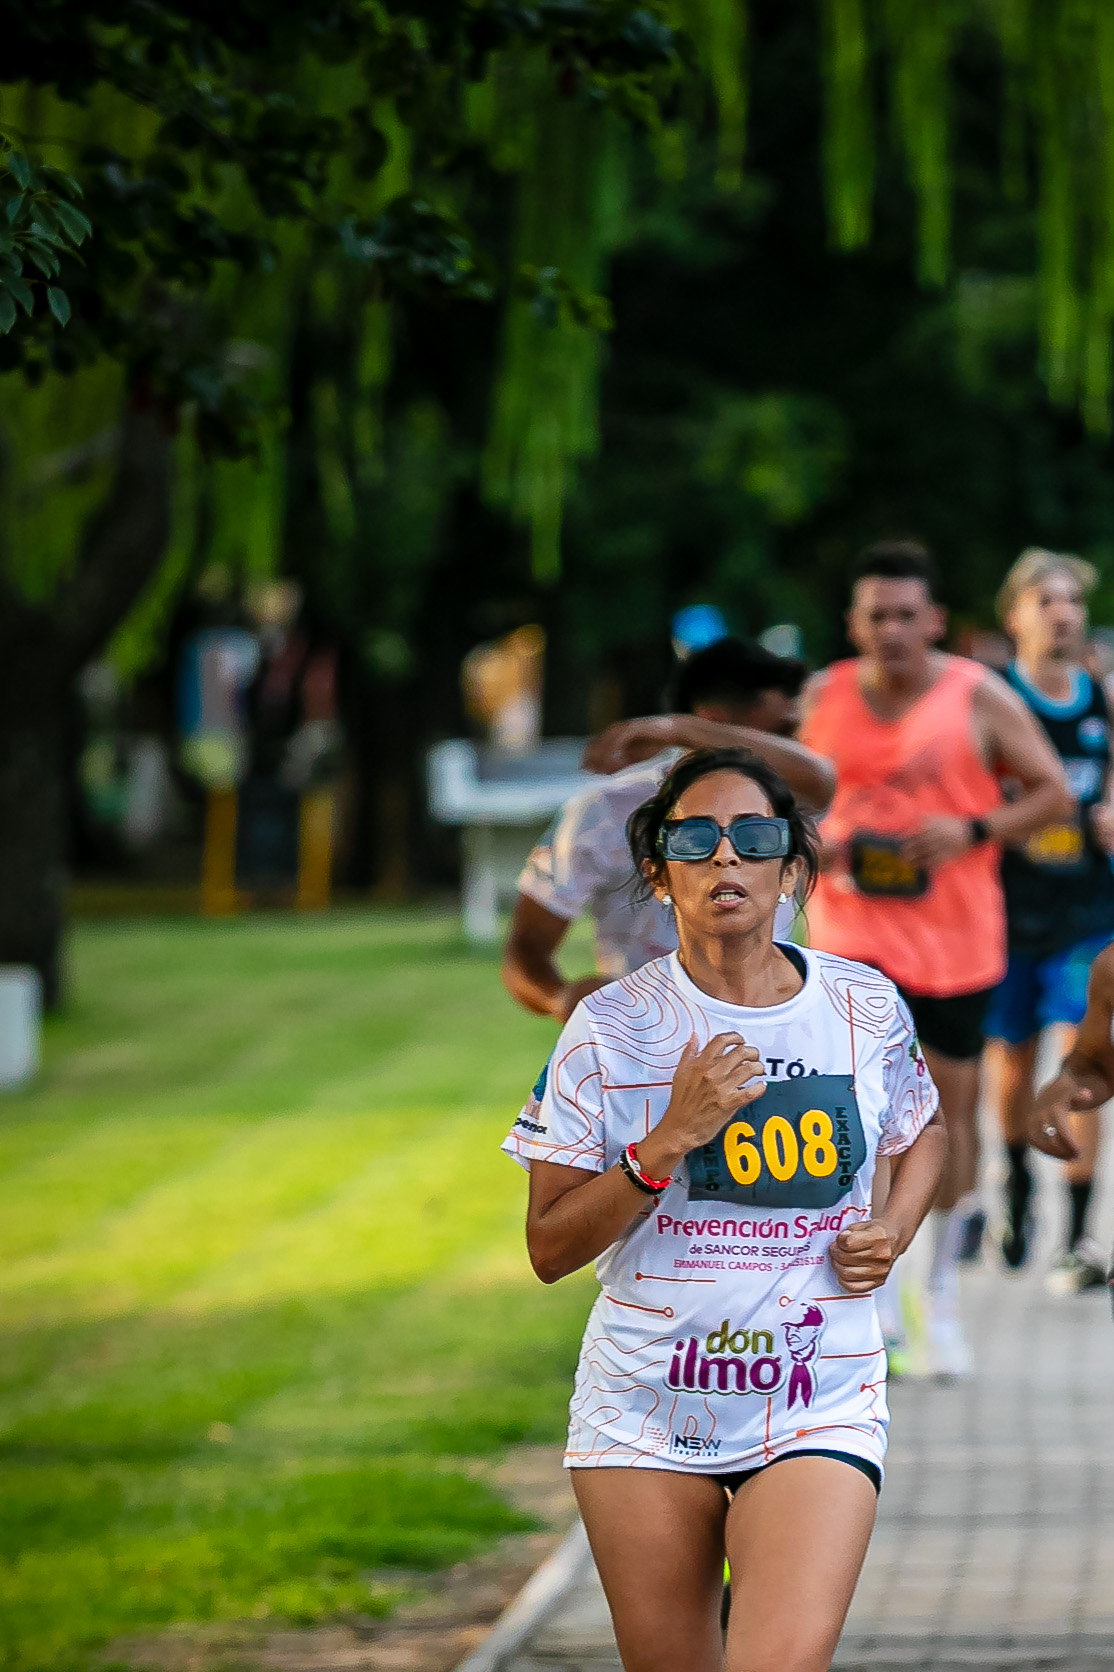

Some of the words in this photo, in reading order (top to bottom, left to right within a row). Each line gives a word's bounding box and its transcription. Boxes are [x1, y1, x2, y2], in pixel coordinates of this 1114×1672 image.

[724, 1109, 838, 1186] 608
[835, 1106, 853, 1187] EXACTO
[657, 1214, 789, 1239] Prevención
[689, 1244, 703, 1255] de
[703, 1243, 759, 1257] SANCOR
[728, 1261, 773, 1272] CAMPOS
[706, 1319, 774, 1354] don
[668, 1336, 783, 1391] ilmo
[674, 1433, 722, 1450] NEW
